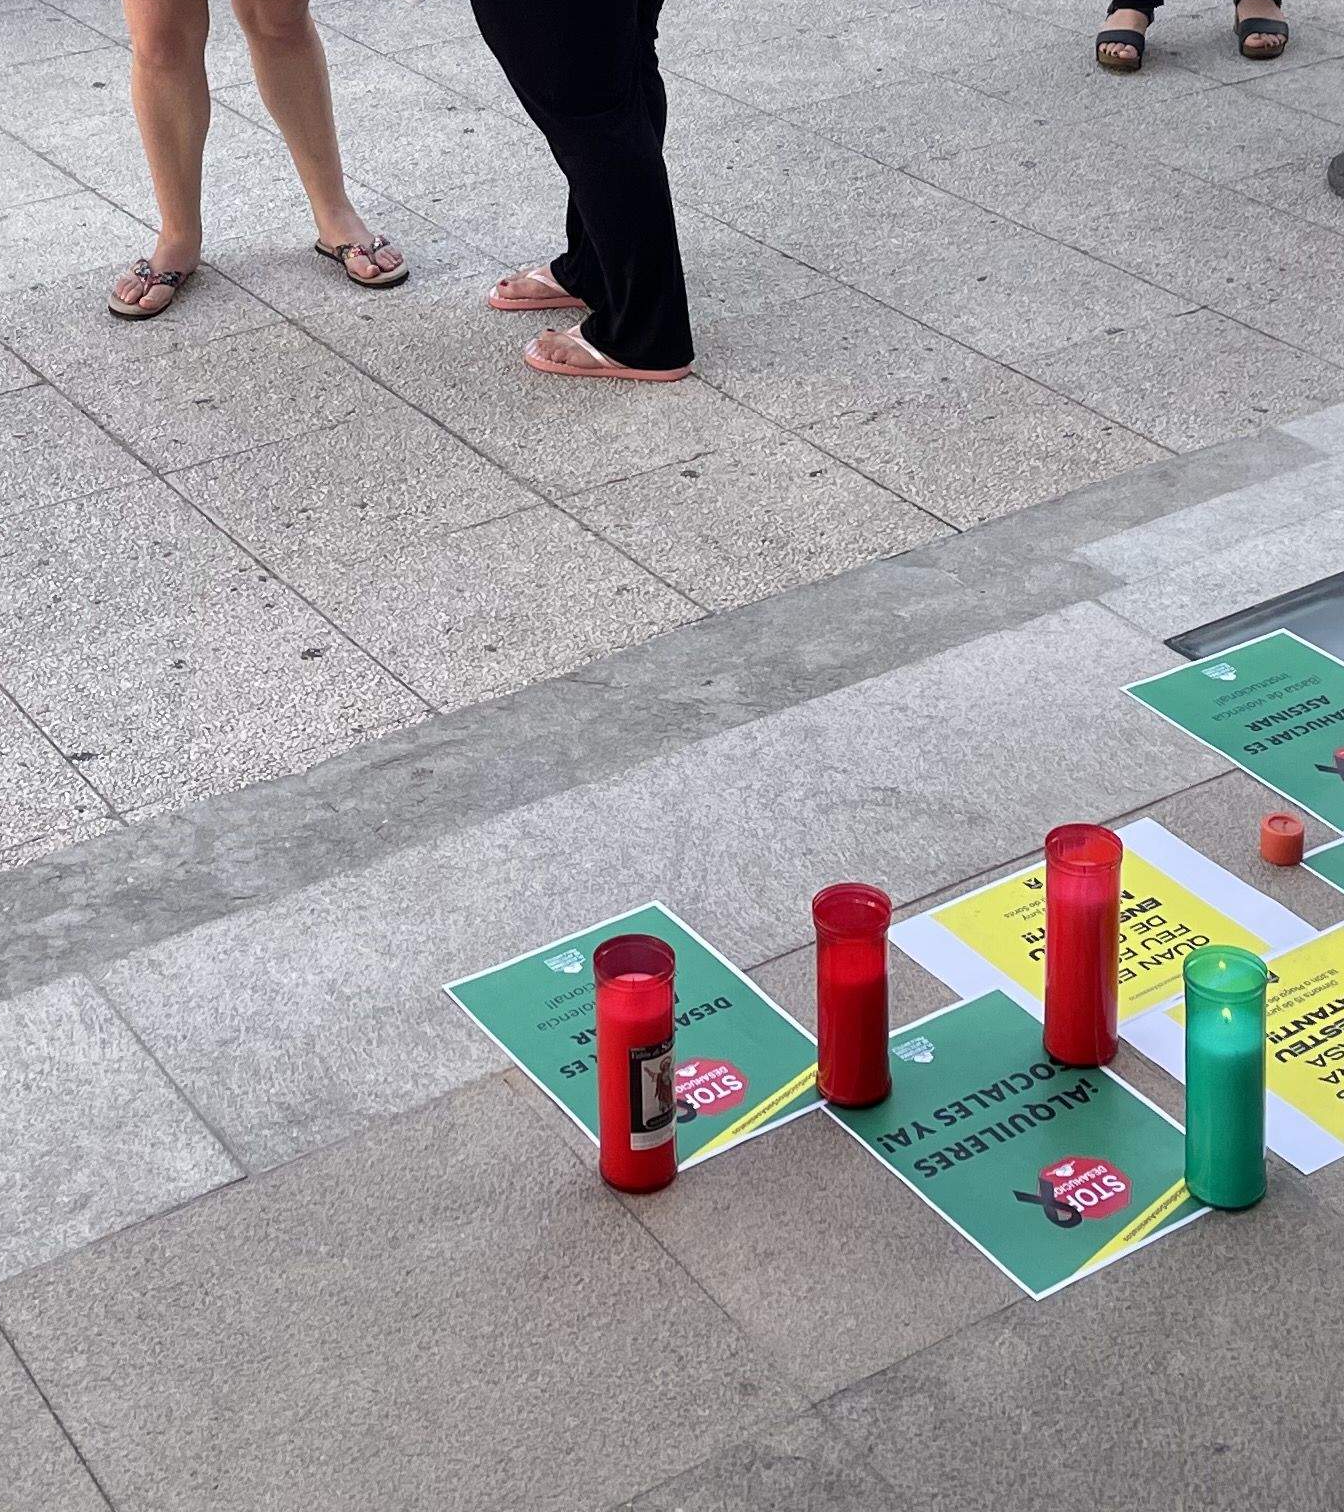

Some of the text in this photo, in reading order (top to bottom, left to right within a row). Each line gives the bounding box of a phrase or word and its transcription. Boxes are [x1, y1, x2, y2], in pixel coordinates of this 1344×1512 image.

[1244, 694, 1332, 733] ASESINAR
[1242, 740, 1269, 756] ES
[1129, 914, 1167, 935] DE
[1140, 923, 1191, 951] FEU
[1139, 934, 1211, 971] QUAN
[559, 1060, 590, 1079] ES
[875, 1119, 938, 1155] YA!
[913, 1077, 1095, 1179] ¡ALQUILERES
